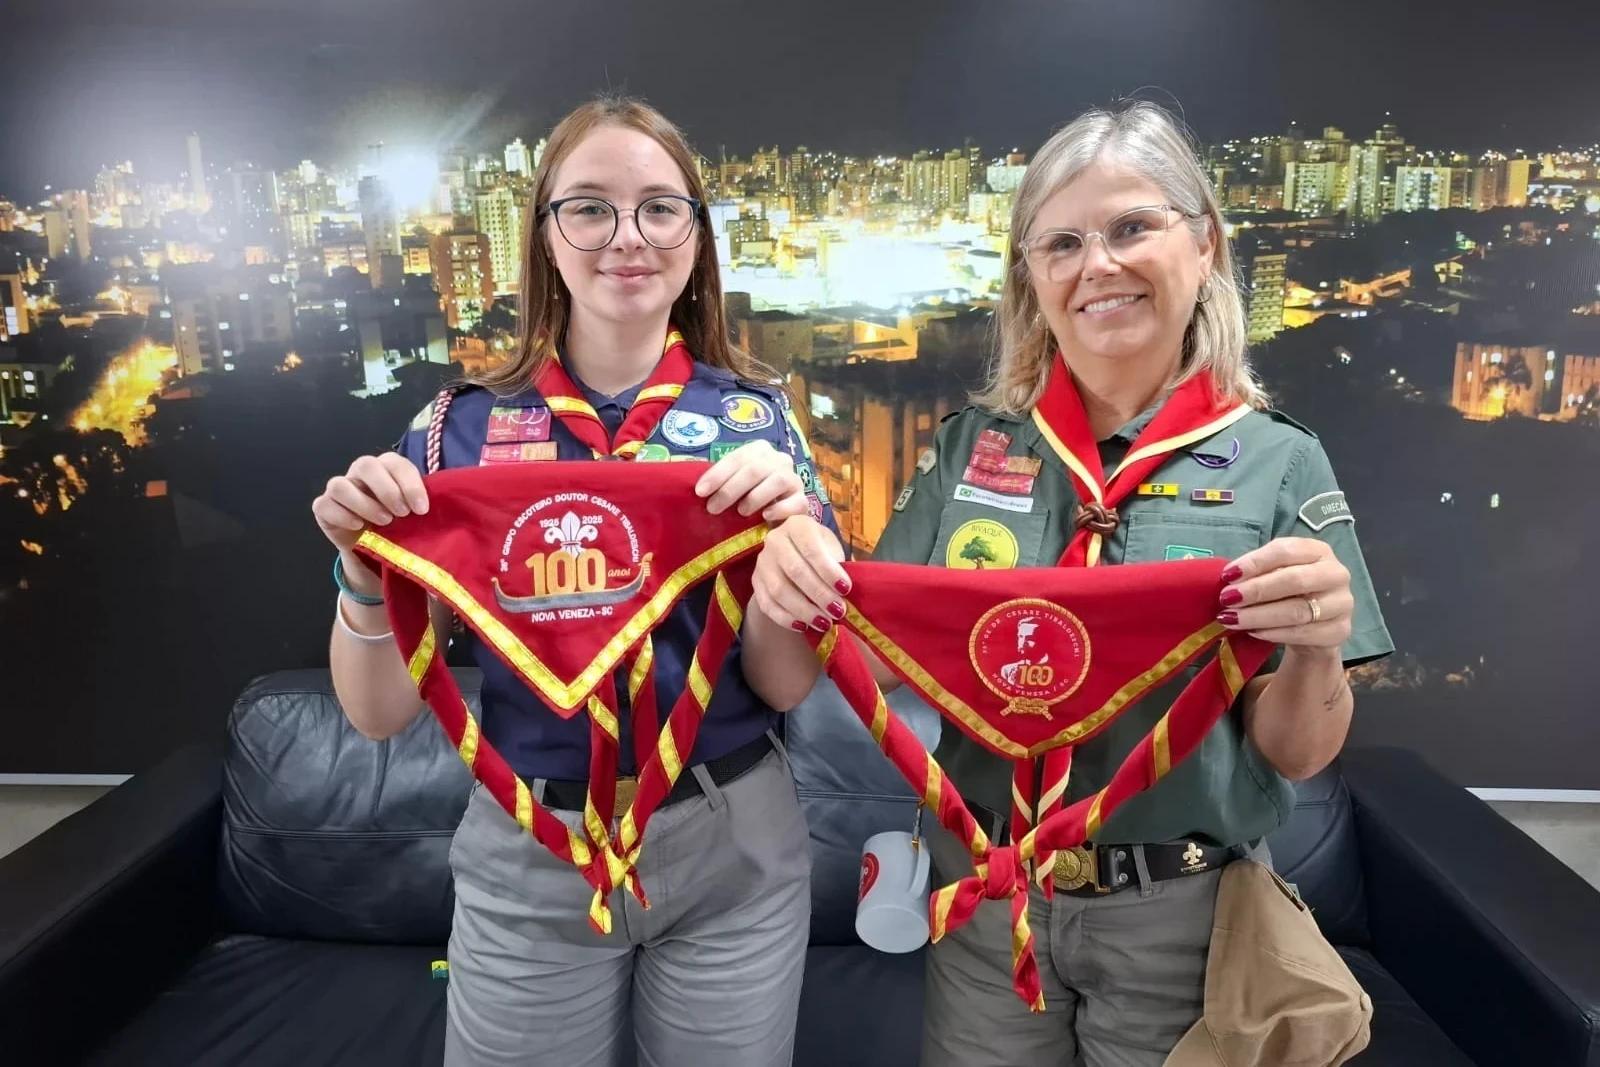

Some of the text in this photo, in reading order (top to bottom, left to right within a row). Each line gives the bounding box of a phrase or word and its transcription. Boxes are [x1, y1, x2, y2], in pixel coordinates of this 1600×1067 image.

[502, 528, 517, 556] GRUPO
[514, 496, 553, 528] ESCOTEIRO
[554, 492, 589, 503] DOUTOR
[590, 495, 622, 517] CESARE
[539, 515, 603, 528] 1925 2025
[525, 547, 607, 598] 100
[532, 611, 556, 623] NOVA
[1006, 609, 1041, 619] CESARE
[1018, 664, 1054, 687] 100
